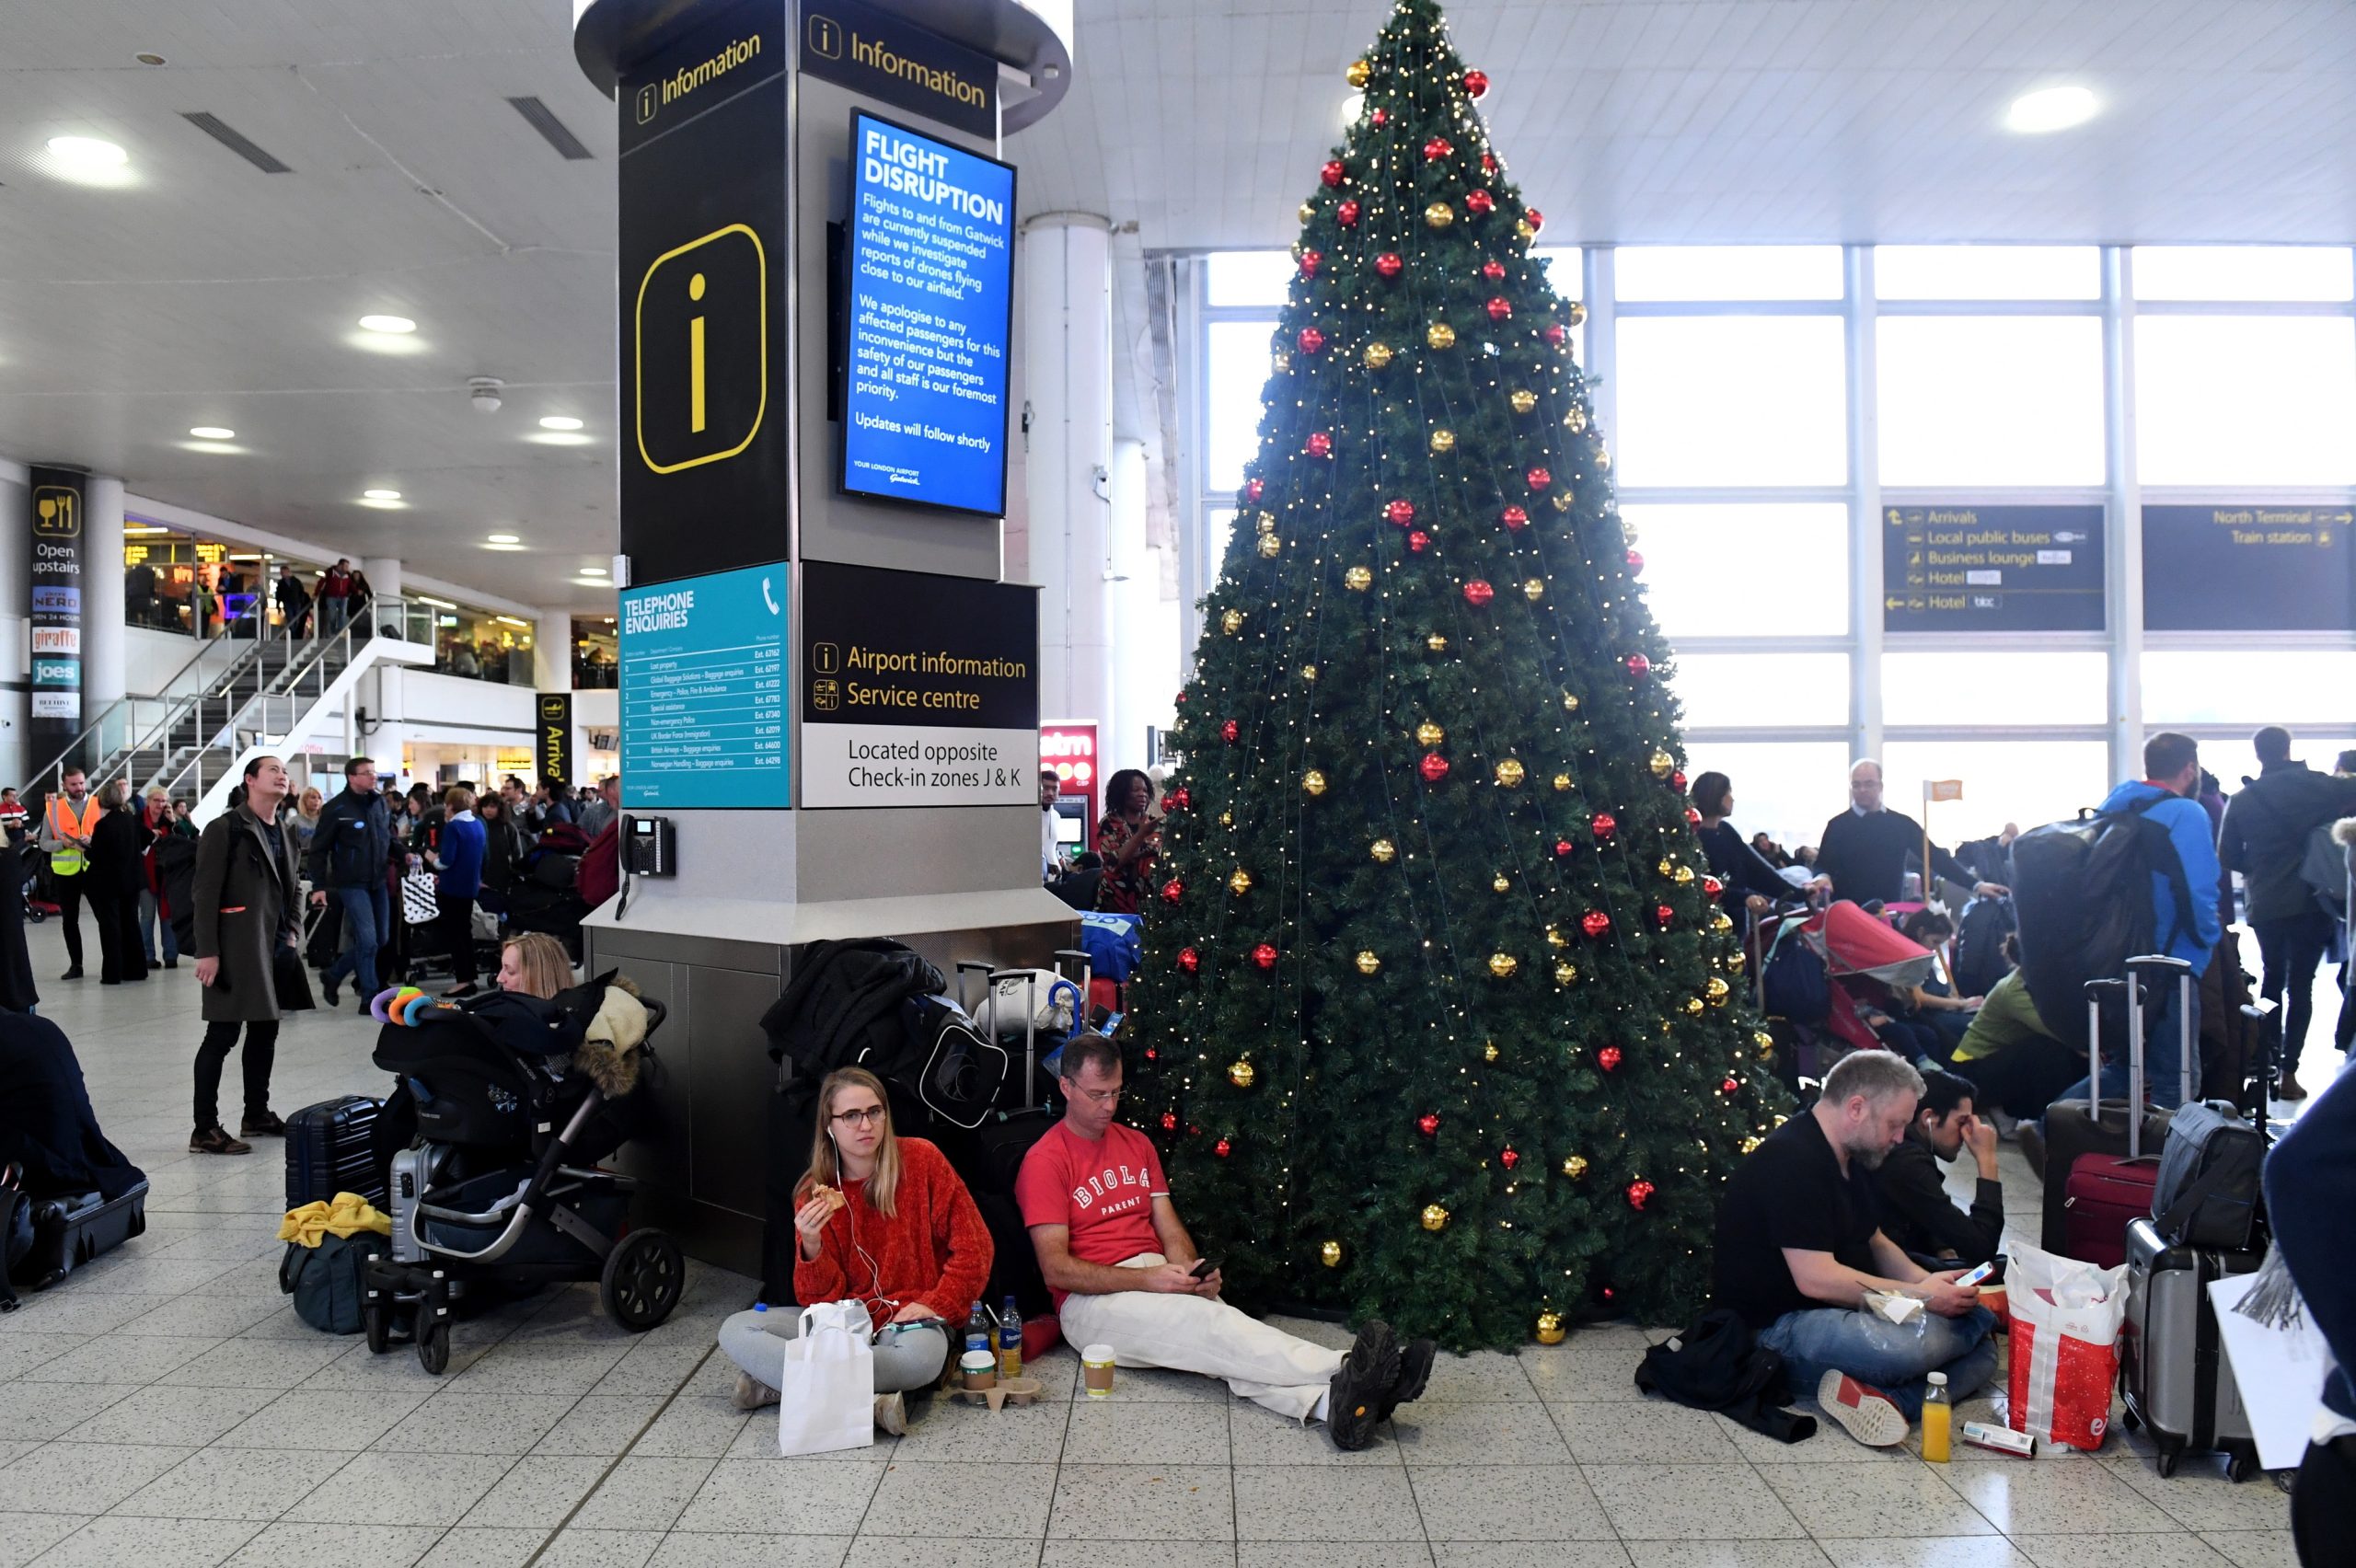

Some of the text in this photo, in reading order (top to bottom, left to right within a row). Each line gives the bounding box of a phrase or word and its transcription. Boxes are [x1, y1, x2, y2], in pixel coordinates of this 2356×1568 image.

[663, 34, 760, 105] Information
[852, 32, 985, 109] Information
[866, 130, 948, 179] FLIGHT
[865, 157, 1003, 225] DISRUPTION
[863, 192, 1004, 248] Flights to and from Gatwick
[862, 212, 986, 259] are currently suspended
[861, 229, 967, 269] while we investigate
[860, 262, 964, 300] close to our airfield.
[861, 247, 982, 293] reports of drones flying
[860, 294, 966, 336] We apologise to any
[858, 329, 973, 367] inconvenience but the
[859, 313, 1000, 358] affected passengers for this
[857, 347, 984, 386] safety of our passengers
[856, 381, 898, 401] priority.
[857, 364, 997, 404] and all staff is our foremost
[855, 411, 990, 453] Updates will follow shortly
[871, 464, 895, 473] LONDON
[896, 467, 919, 477] AIRPORT
[1928, 511, 1978, 525] Arrivals
[2213, 510, 2312, 525] North Terminal
[1928, 531, 1963, 545] Local
[1967, 531, 2008, 547] public
[2012, 531, 2050, 545] buses
[2231, 529, 2312, 544] Train station
[37, 543, 75, 559] Open
[1928, 551, 1985, 565] Business
[1989, 550, 2036, 568] lounge
[32, 560, 80, 575] upstairs
[1928, 571, 1965, 584] Hotel
[35, 597, 76, 607] NERD
[625, 591, 694, 617] TELEPHONE
[1928, 595, 1966, 609] Hotel
[626, 609, 688, 634] ENQUIRIES
[35, 629, 76, 650] giraffe
[36, 662, 75, 683] joes
[848, 646, 1026, 678] Airport information
[755, 681, 765, 689] Ext.
[848, 682, 980, 709] Service centre
[755, 696, 765, 704] Ext.
[755, 711, 765, 720] Ext.
[755, 742, 764, 750] Ext.
[849, 739, 998, 766] Located opposite
[848, 767, 1021, 787] Check-in zones J & K
[1073, 1165, 1149, 1209] BIOLA
[1101, 1196, 1141, 1216] PARENT
